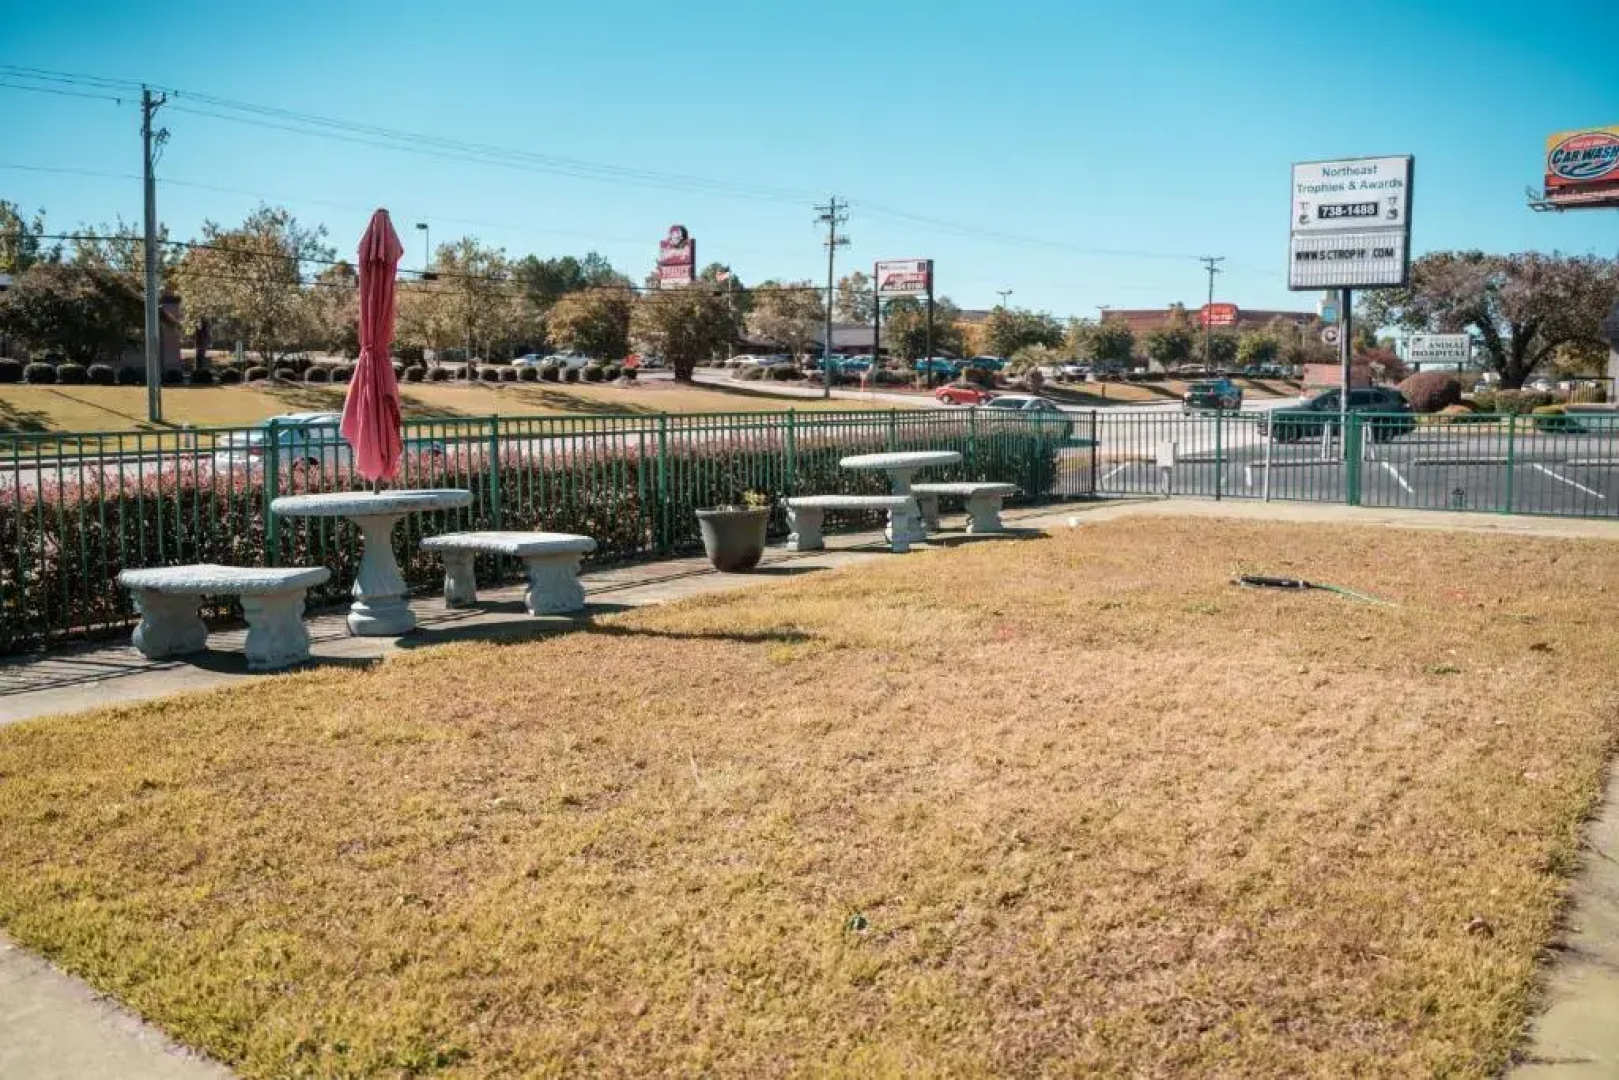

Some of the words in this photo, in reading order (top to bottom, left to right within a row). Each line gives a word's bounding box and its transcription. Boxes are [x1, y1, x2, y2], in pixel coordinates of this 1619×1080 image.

[1552, 147, 1581, 164] CAR
[1322, 165, 1378, 177] Northeast
[1297, 181, 1345, 194] Trophies
[1348, 181, 1357, 190] &
[1360, 177, 1403, 189] Awards
[1320, 204, 1376, 217] 738-1488
